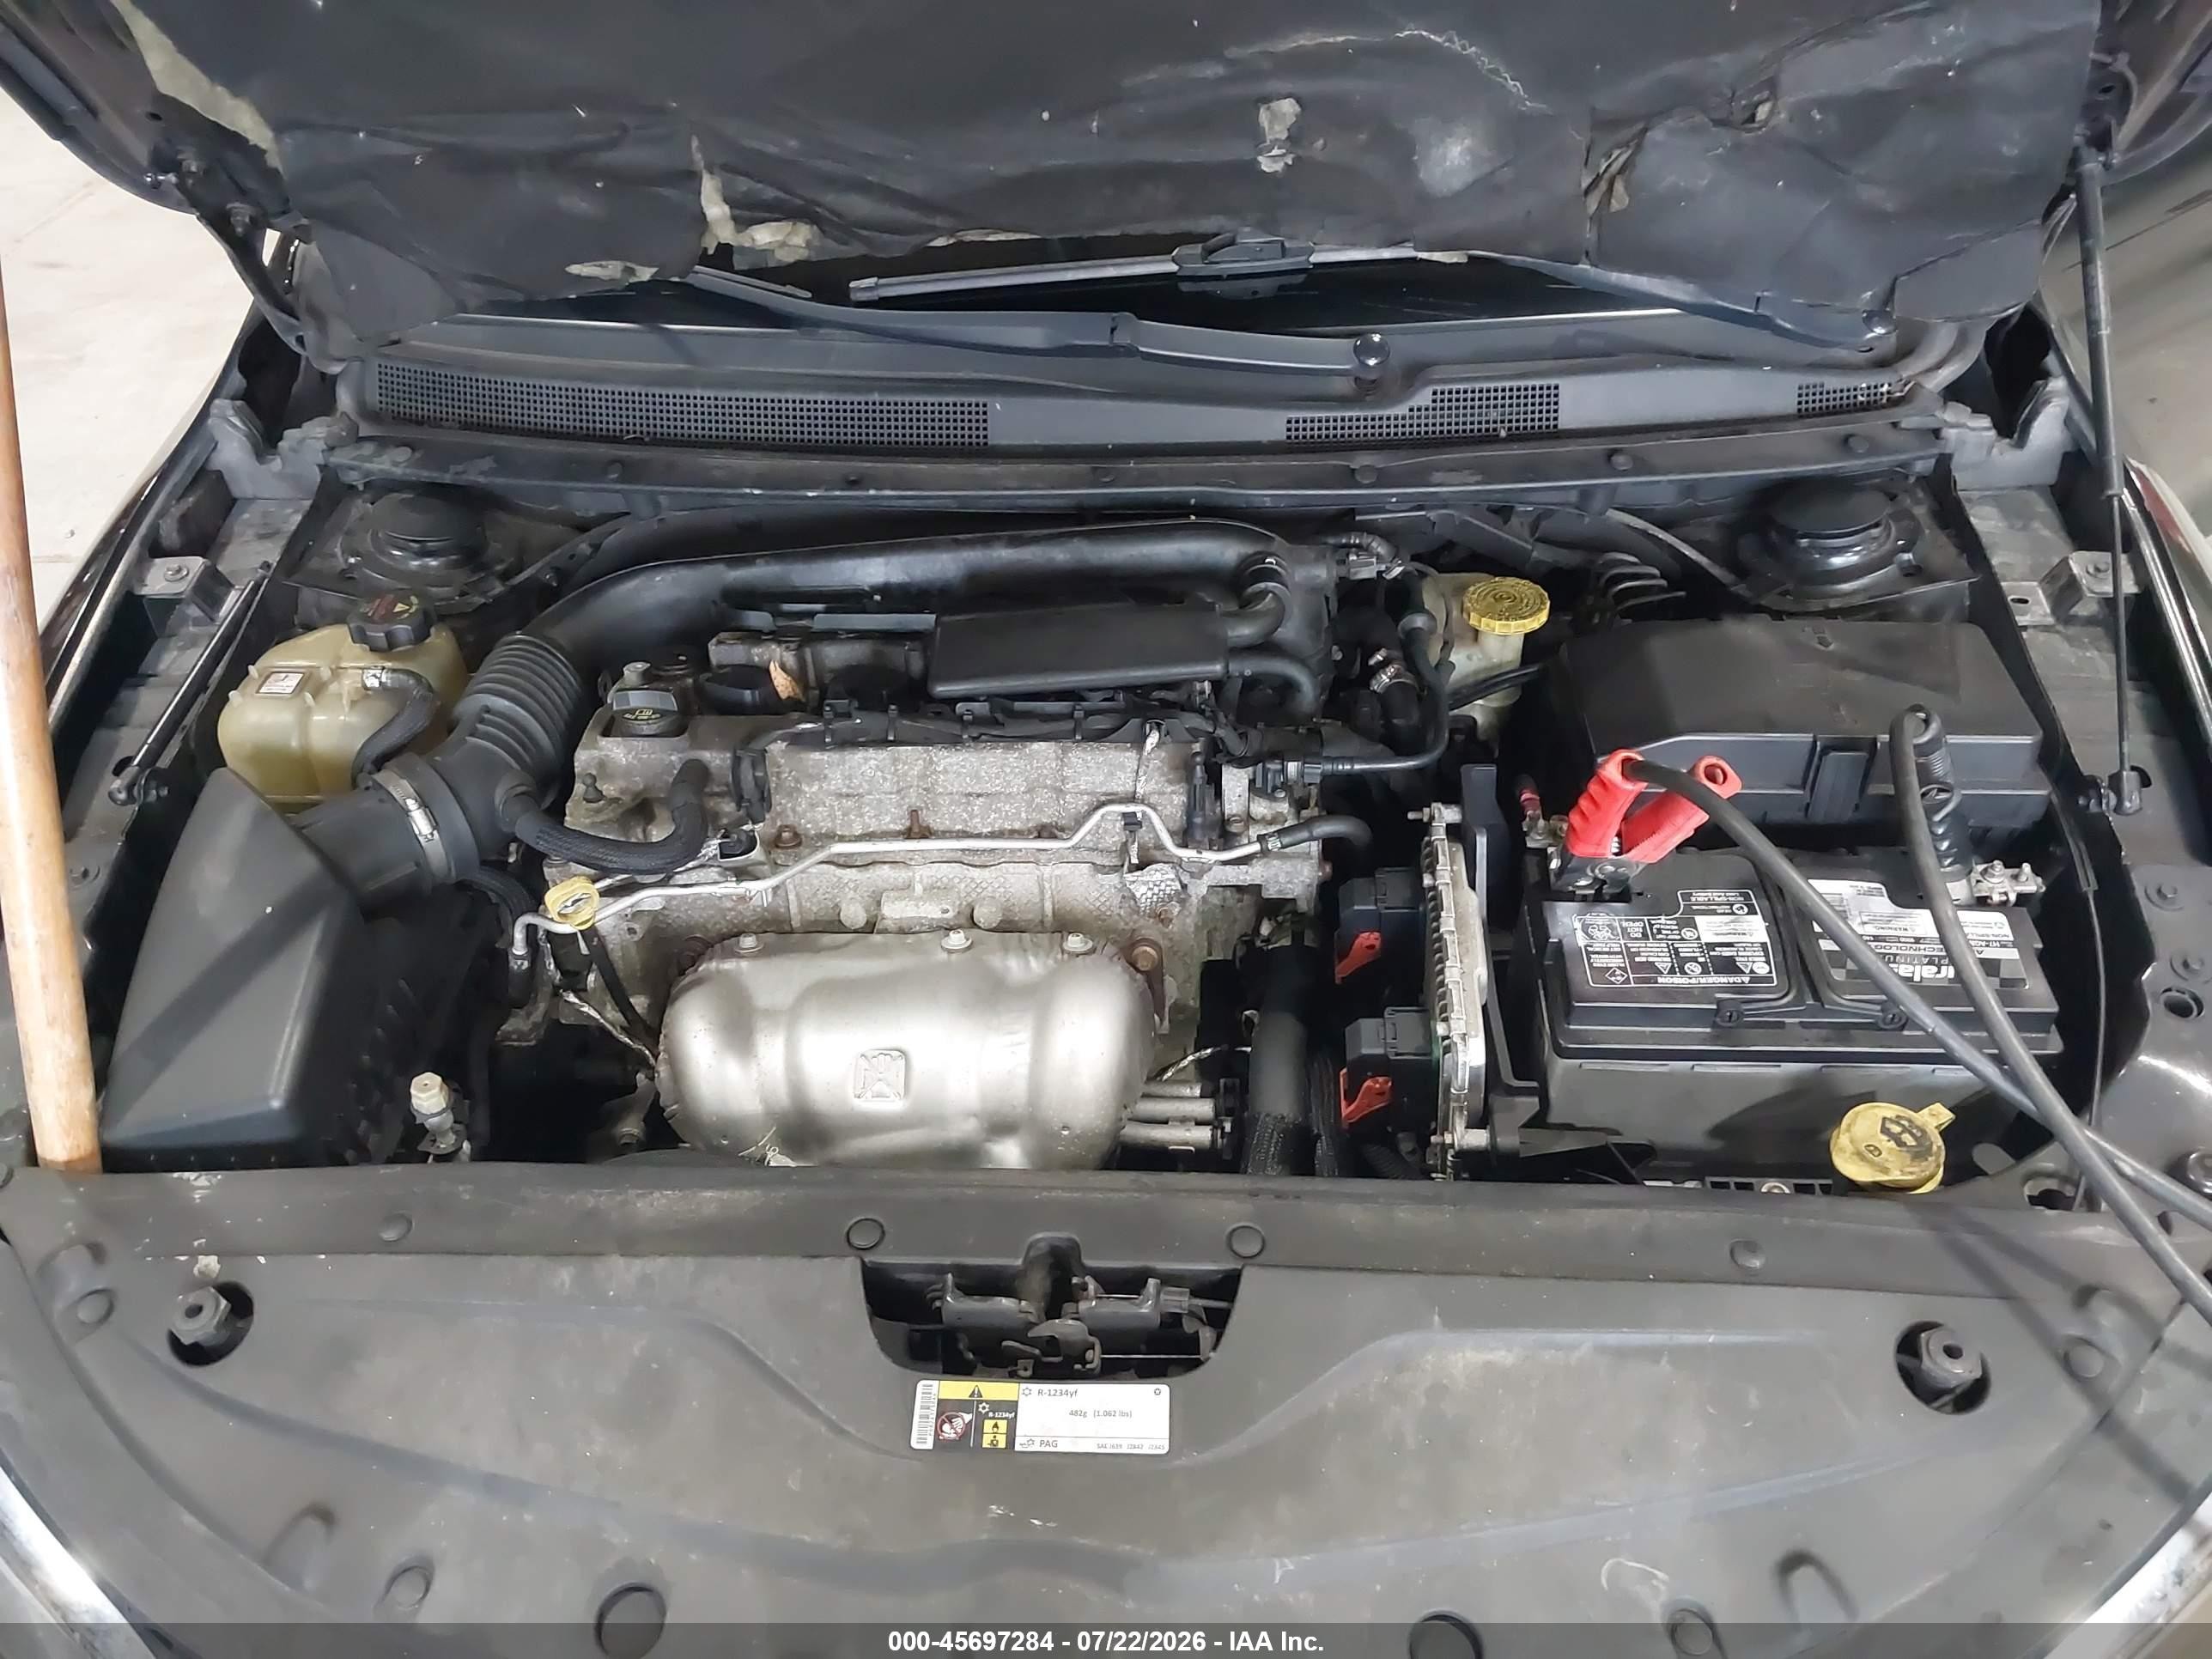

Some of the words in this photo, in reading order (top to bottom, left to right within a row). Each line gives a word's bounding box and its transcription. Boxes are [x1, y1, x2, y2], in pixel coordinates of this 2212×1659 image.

[1872, 944, 1944, 953] ECHNOLOG
[1881, 955, 1948, 965] PLATINU
[1037, 1389, 1078, 1398] R-1234yf
